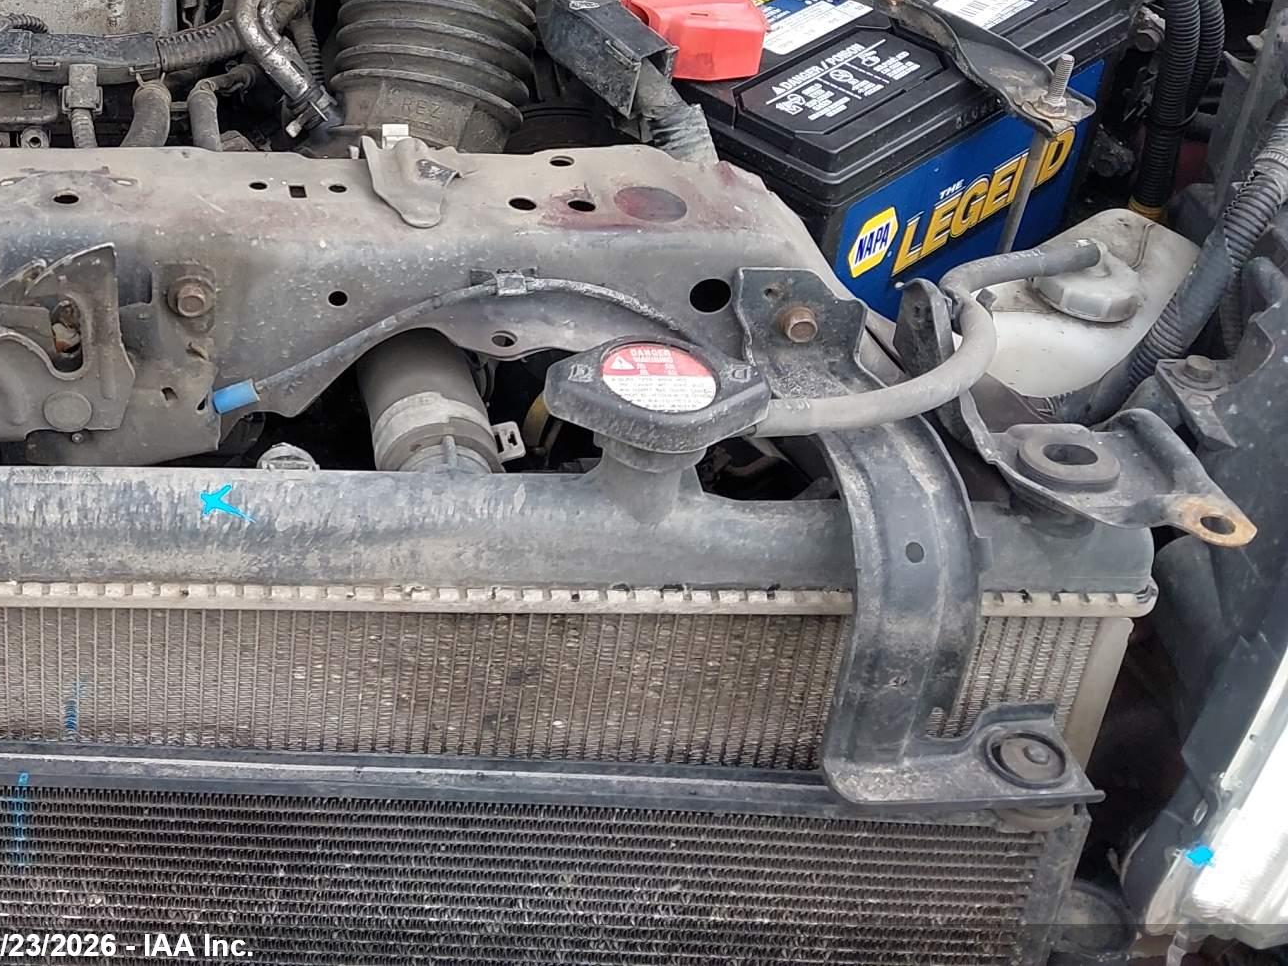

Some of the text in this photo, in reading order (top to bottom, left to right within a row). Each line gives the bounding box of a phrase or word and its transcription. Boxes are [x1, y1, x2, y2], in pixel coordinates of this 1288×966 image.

[778, 65, 825, 91] DANGER
[824, 42, 866, 66] POISON
[939, 179, 965, 200] THE
[854, 222, 891, 266] NAPA
[630, 348, 672, 358] DANGER
